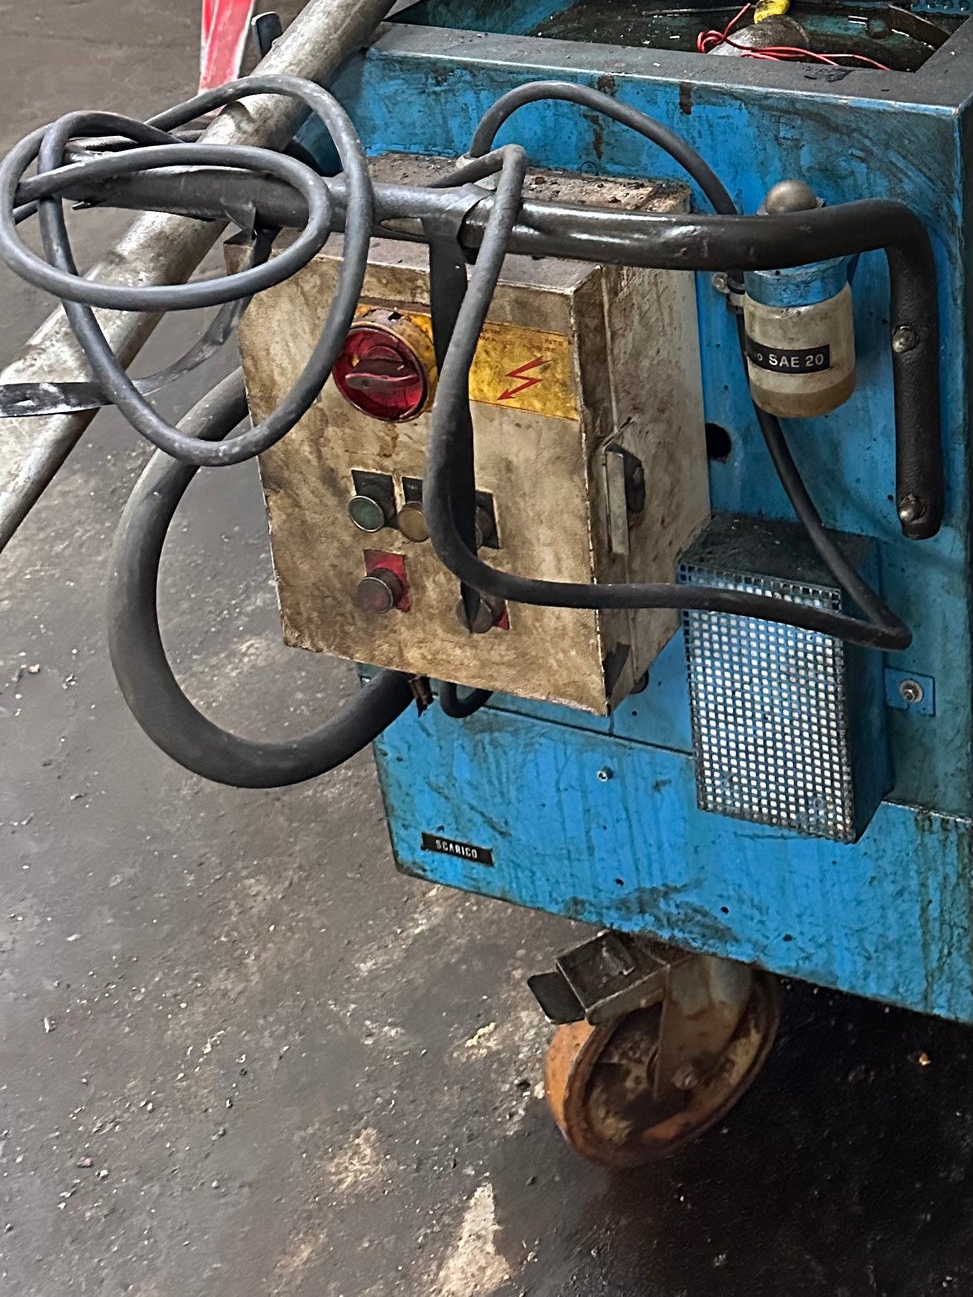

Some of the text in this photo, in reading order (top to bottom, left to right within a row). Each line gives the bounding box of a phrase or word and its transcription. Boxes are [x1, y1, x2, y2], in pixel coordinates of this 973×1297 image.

[768, 353, 800, 368] SAE
[805, 353, 825, 367] 20
[435, 838, 479, 859] SCARICO
